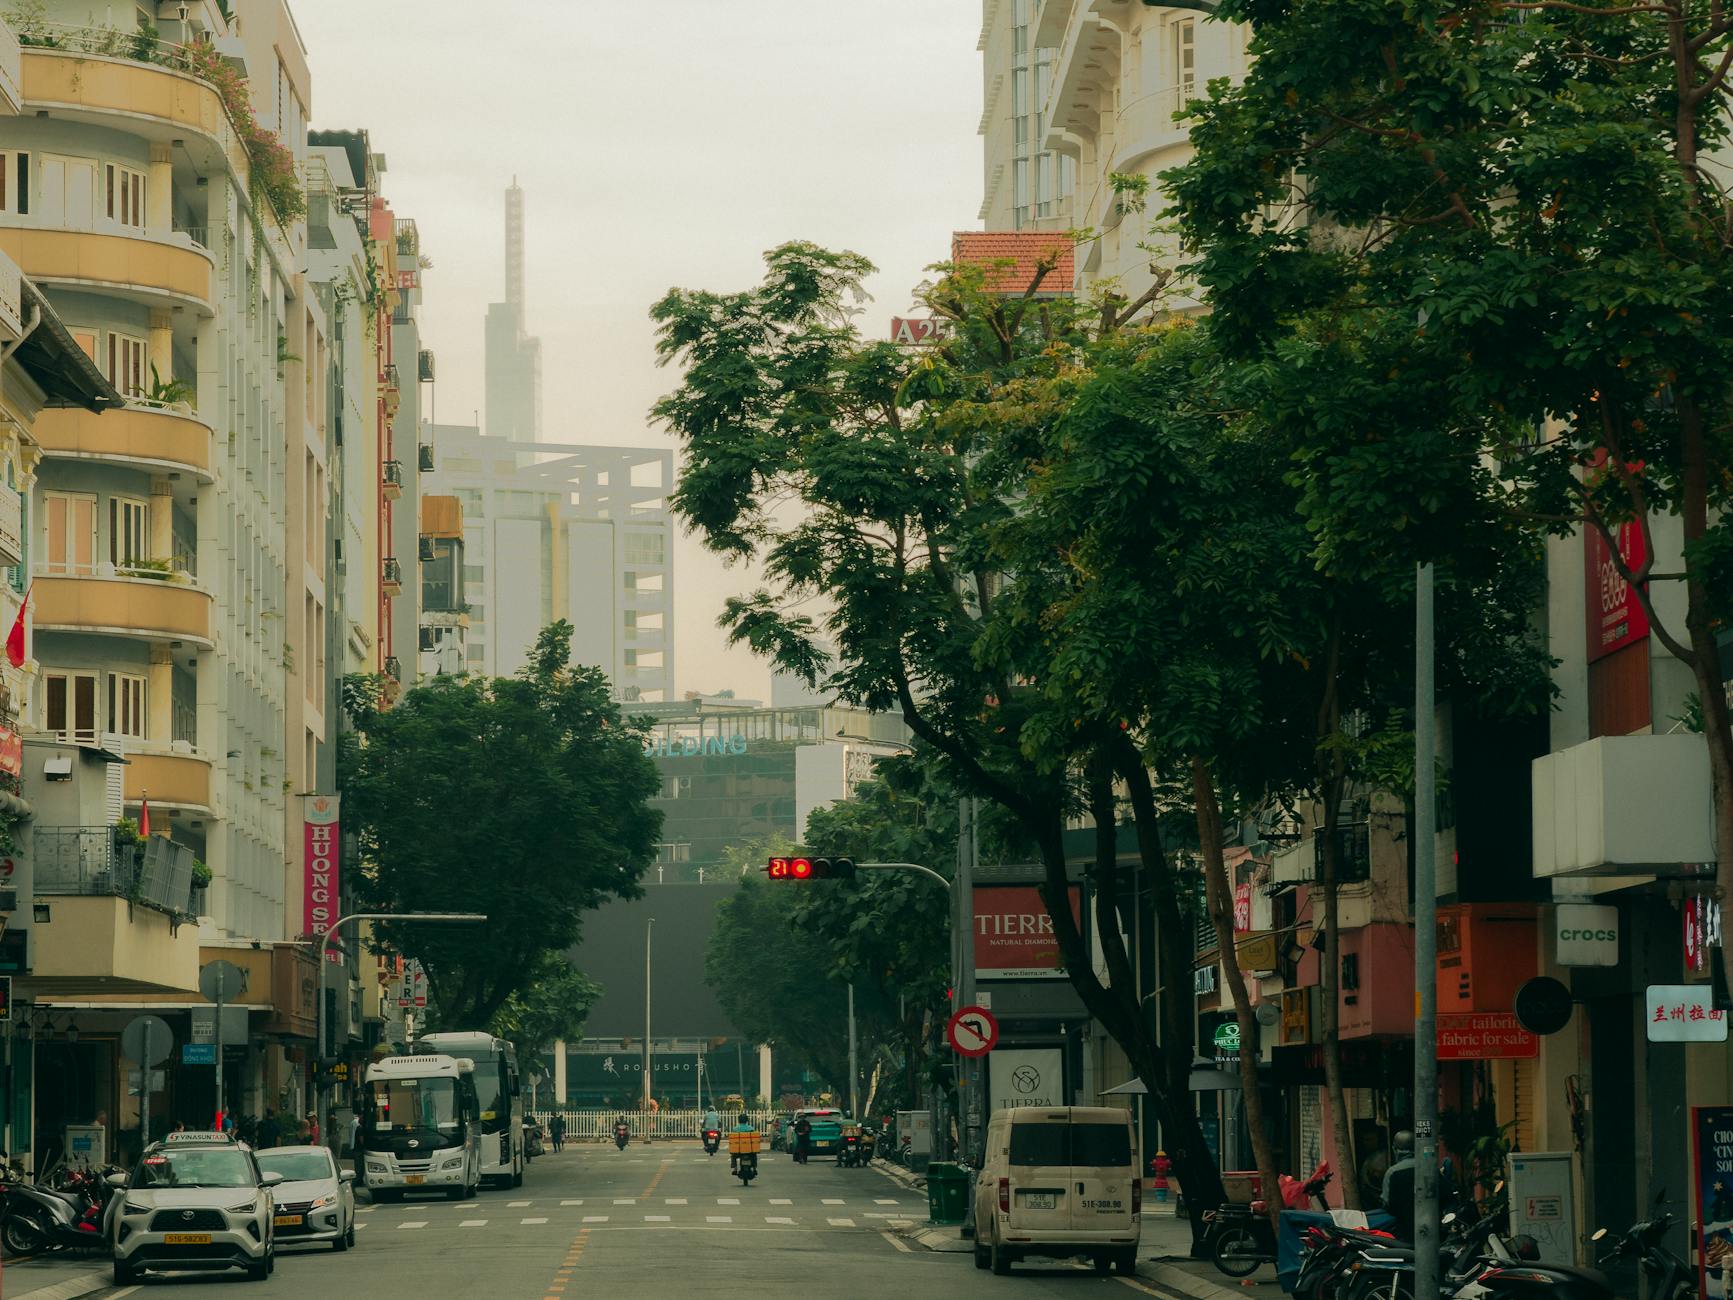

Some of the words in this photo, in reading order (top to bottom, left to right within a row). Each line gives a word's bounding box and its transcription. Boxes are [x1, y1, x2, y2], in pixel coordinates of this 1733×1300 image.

[312, 827, 332, 903] HUONG
[772, 861, 788, 876] 21
[974, 914, 1056, 935] TIERR
[1560, 929, 1616, 942] crocs
[1473, 1016, 1522, 1030] tailorin
[1442, 1032, 1480, 1046] fabric
[1482, 1031, 1502, 1046] for
[1503, 1032, 1529, 1046] sale
[623, 1063, 691, 1072] ROUSHO
